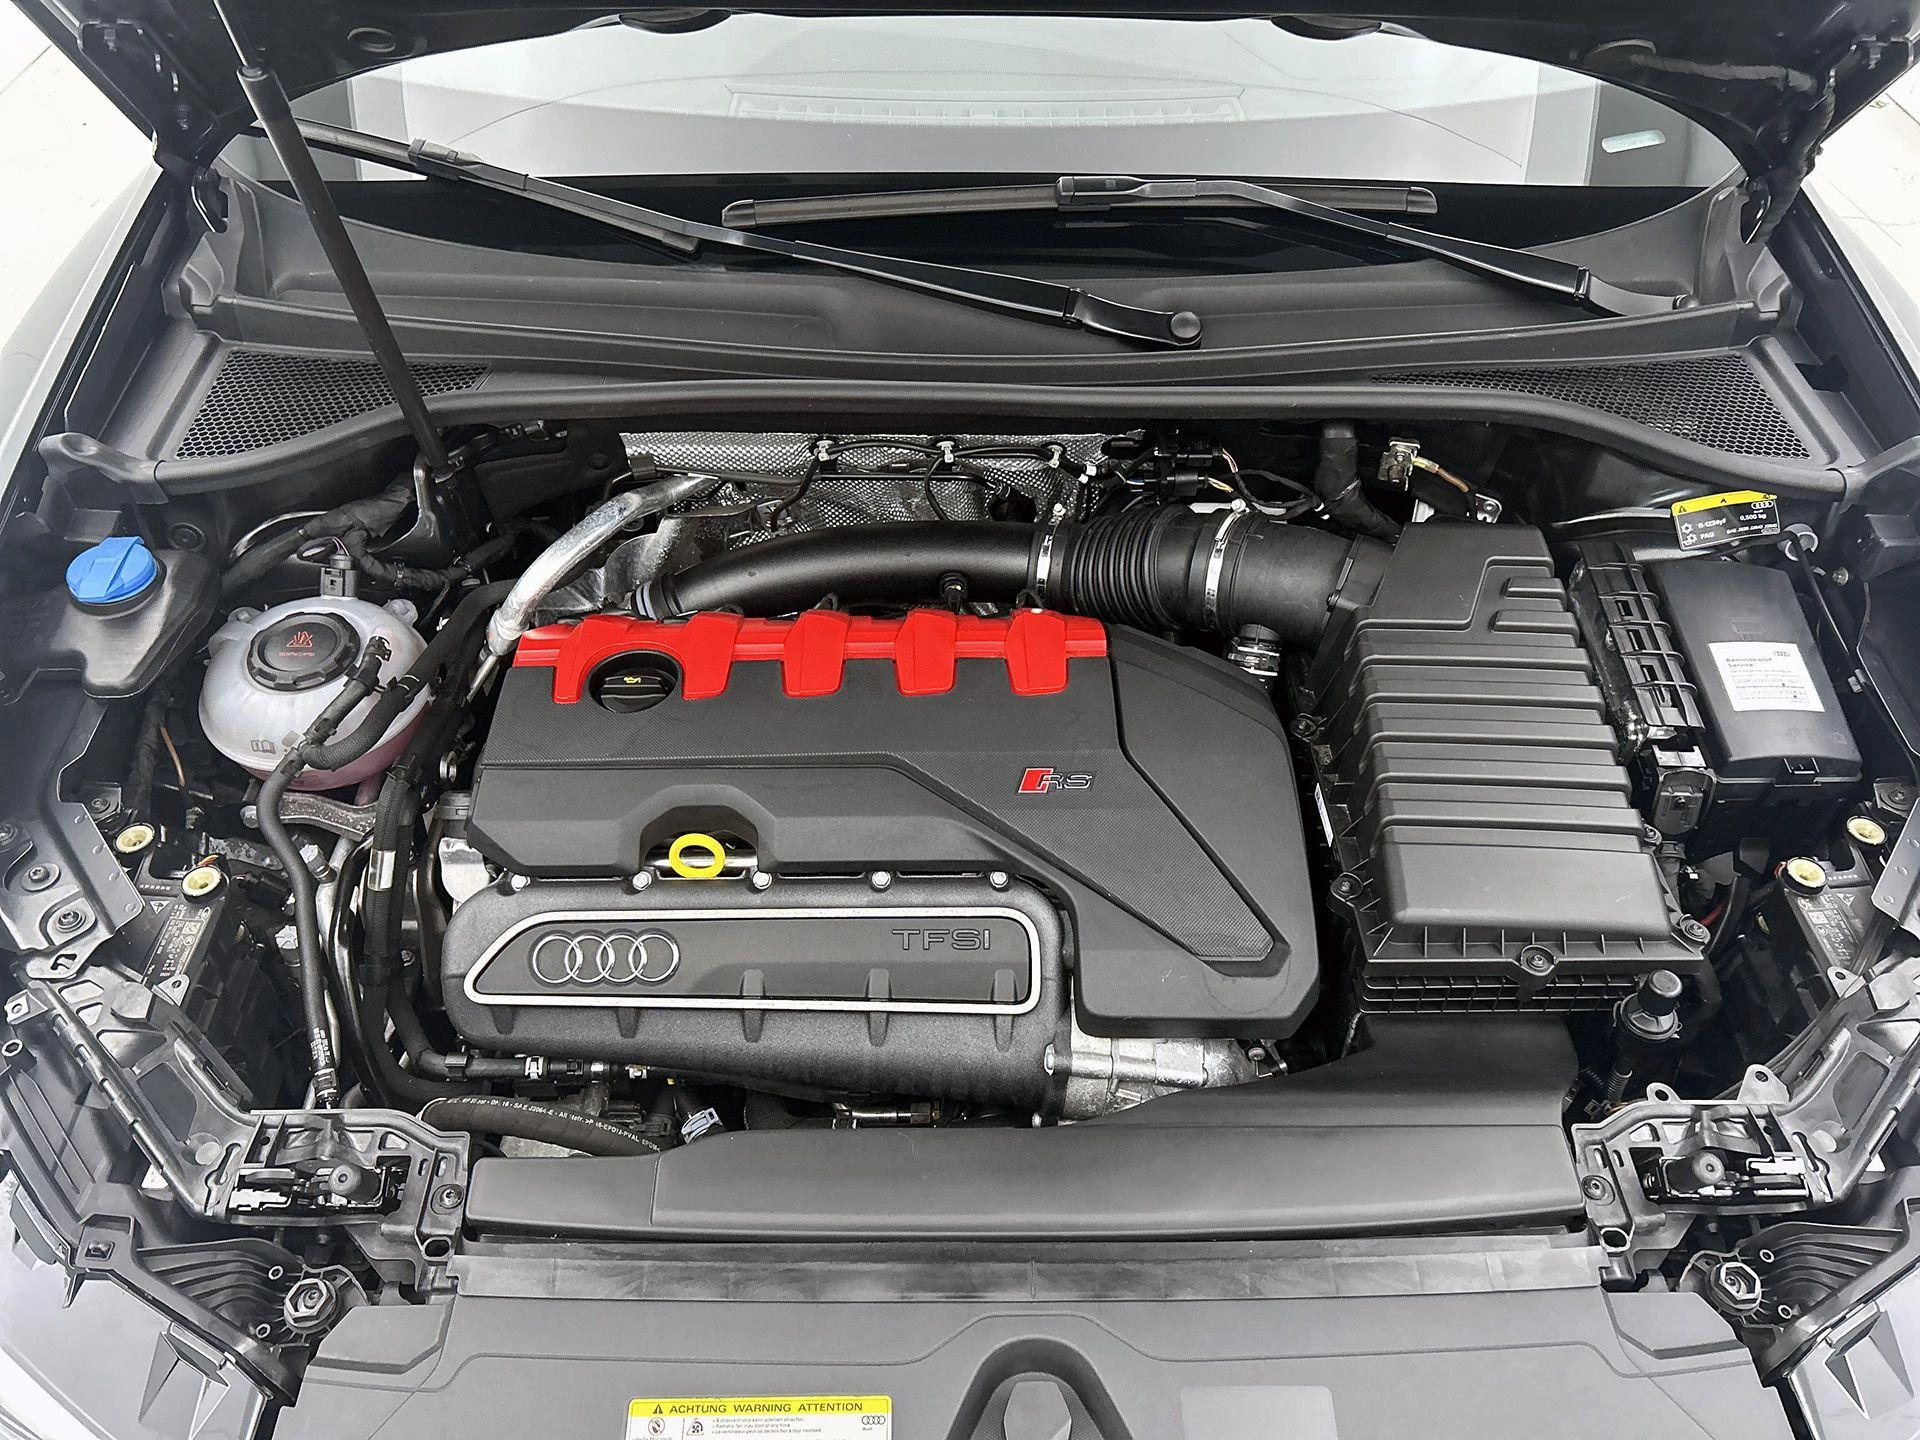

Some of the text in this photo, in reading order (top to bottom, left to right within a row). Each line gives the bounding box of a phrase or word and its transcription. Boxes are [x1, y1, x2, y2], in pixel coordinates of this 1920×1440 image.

[892, 928, 991, 951] TFSI
[513, 1102, 528, 1111] SAE
[669, 1402, 863, 1414] ACHTUNG WARNING ATTENTION
